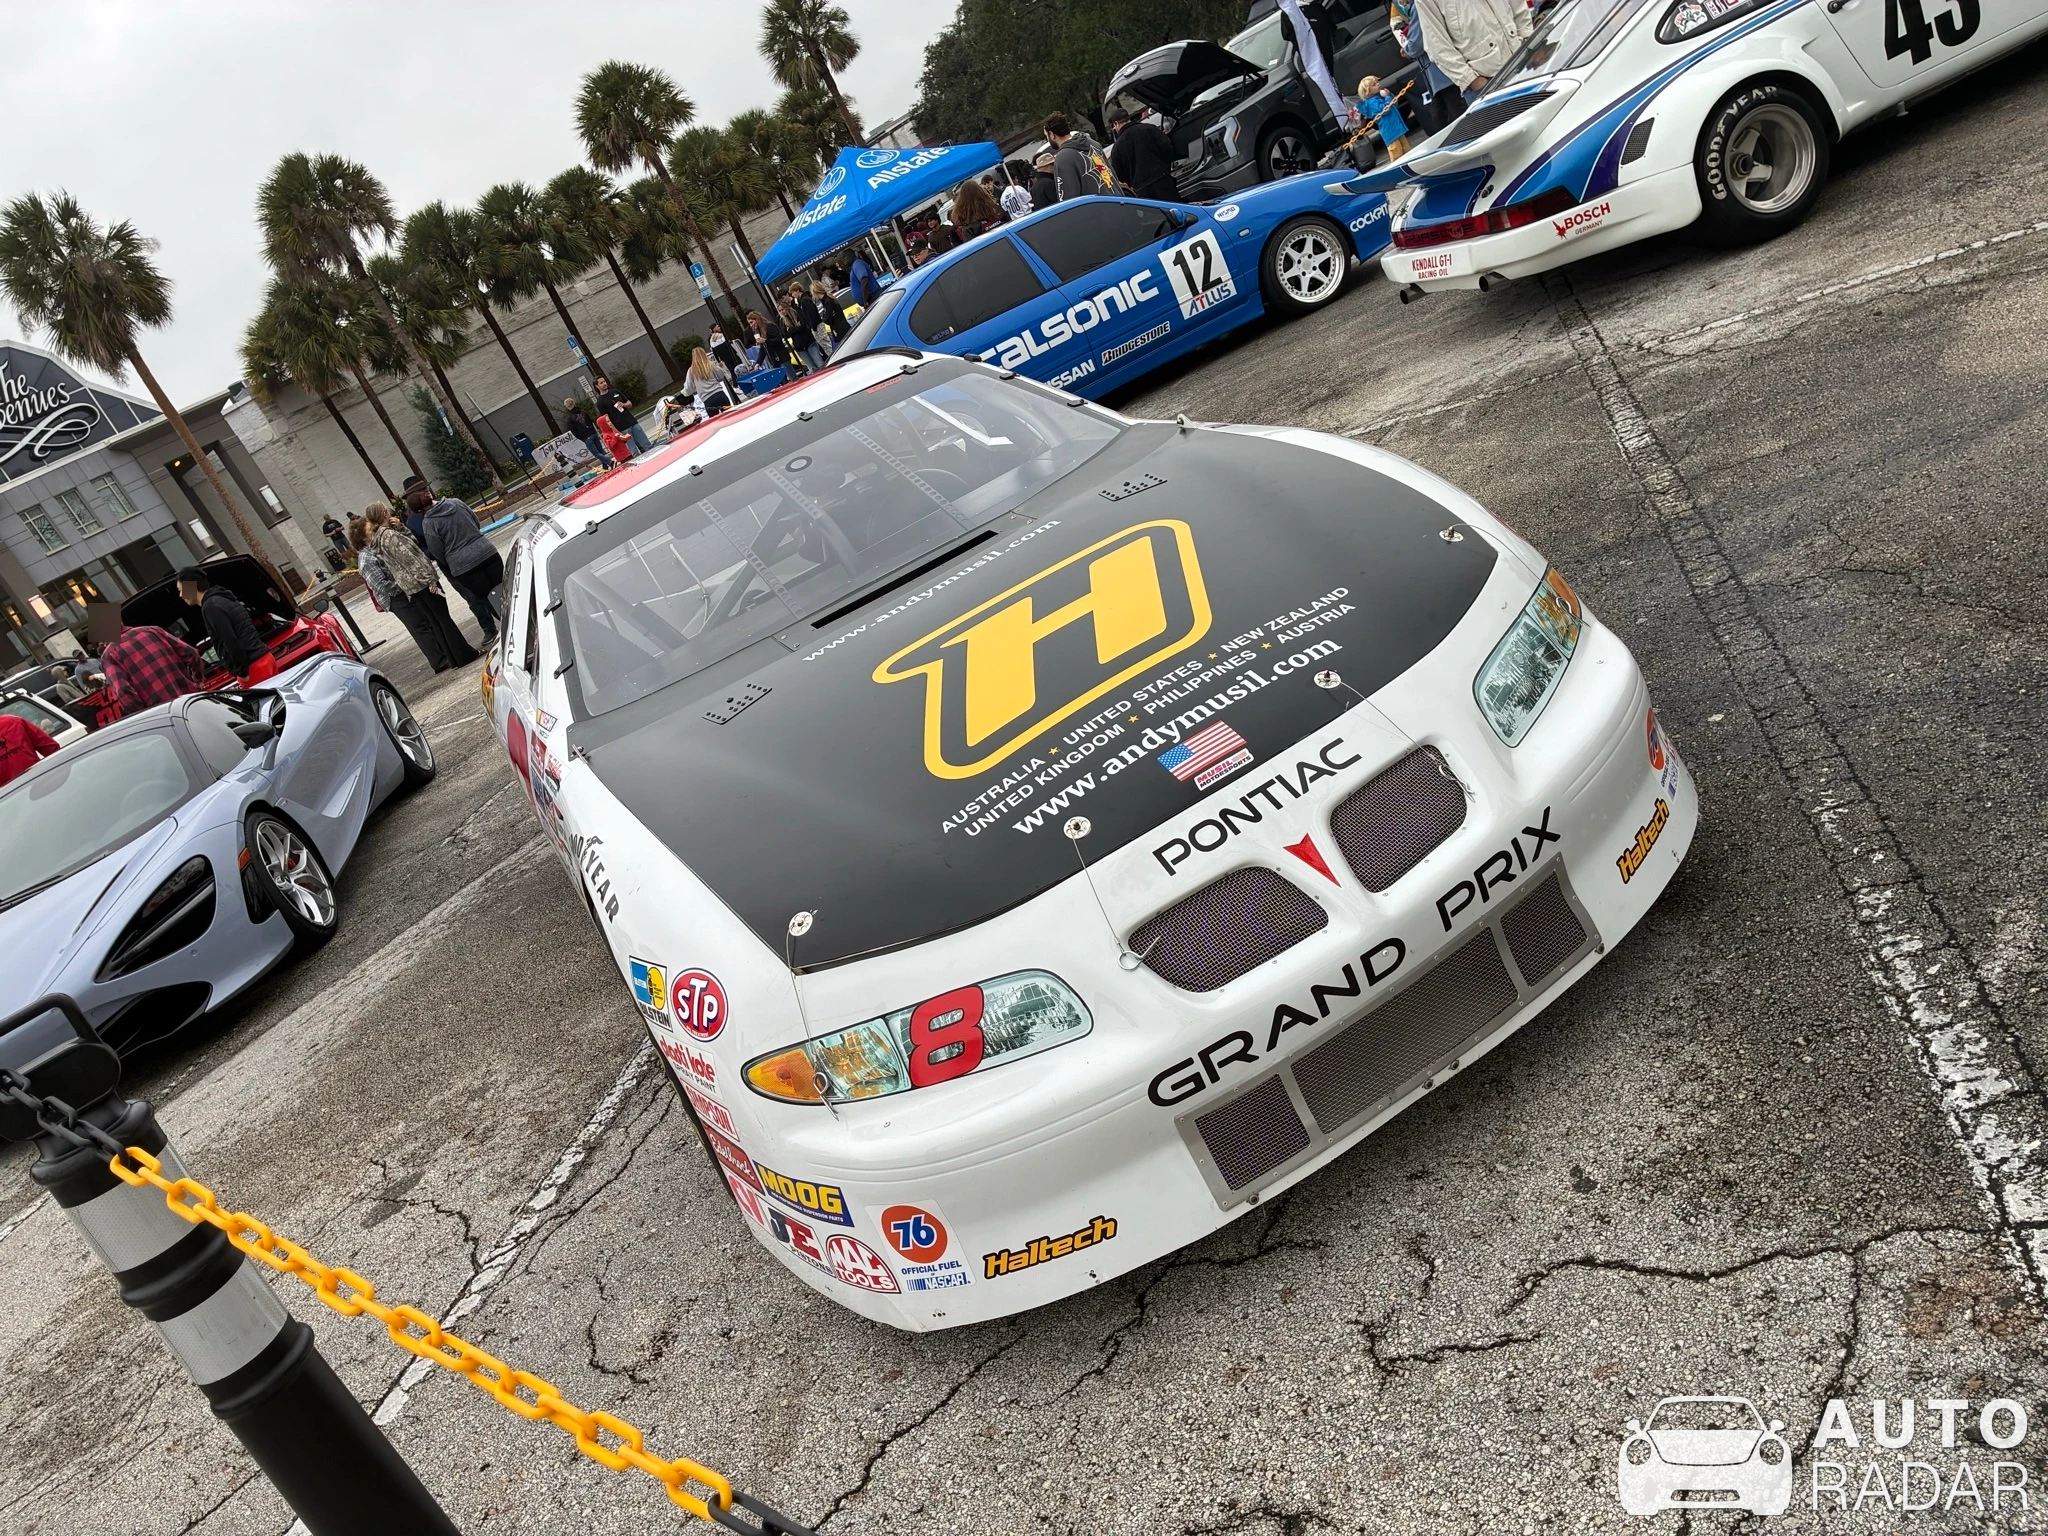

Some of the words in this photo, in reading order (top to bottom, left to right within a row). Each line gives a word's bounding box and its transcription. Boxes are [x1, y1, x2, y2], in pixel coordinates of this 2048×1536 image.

[1706, 85, 1778, 200] GOODYEAR
[1349, 202, 1388, 233] COCKPIT
[1563, 202, 1611, 230] BOSCH
[1574, 219, 1603, 235] GERMANY
[1171, 238, 1223, 298] 12
[1411, 255, 1439, 271] KENDALL
[1439, 253, 1453, 268] GT-1
[1417, 269, 1438, 280] RACING
[1438, 268, 1449, 276] OIL
[1187, 282, 1232, 317] ATLUS
[1101, 320, 1171, 368] BRIDGESTONE
[1044, 358, 1096, 390] ISSAN
[801, 518, 1062, 662] www.andymusil.com
[941, 757, 1046, 834] AUSTRALIA
[1062, 699, 1132, 746] UNITED
[1132, 659, 1203, 702] STATES
[1220, 626, 1266, 653] NEW
[1264, 586, 1350, 632] ZEALAND
[964, 784, 1034, 837] UNITED
[1034, 723, 1126, 787] KINGDOM
[1143, 650, 1257, 715] PHILIPPINES
[1276, 602, 1357, 645] AUSTRIA
[1011, 638, 1344, 836] www.andymusil.com
[1196, 760, 1234, 784] MUSIL
[1199, 754, 1252, 789] MOTORSPORTS
[1152, 736, 1363, 878] PONTIAC
[1616, 797, 1670, 885] Haltech
[1147, 936, 1407, 1109] GRAND
[1435, 805, 1562, 933] PRIX
[677, 976, 720, 1030] STP
[908, 983, 985, 1089] 8
[695, 1075, 717, 1094] PAINT
[757, 1165, 844, 1215] MOOG
[768, 1206, 823, 1262] JE
[802, 1207, 829, 1219] SUSPENSION
[828, 1214, 844, 1223] PARTS
[891, 1214, 937, 1250] 76
[828, 1238, 884, 1276] MAC
[984, 1214, 1118, 1281] Haltech
[838, 1268, 895, 1290] TOOLS
[901, 1264, 938, 1275] OFFICIAL
[938, 1260, 963, 1270] FUEL
[924, 1272, 968, 1289] NASCAR
